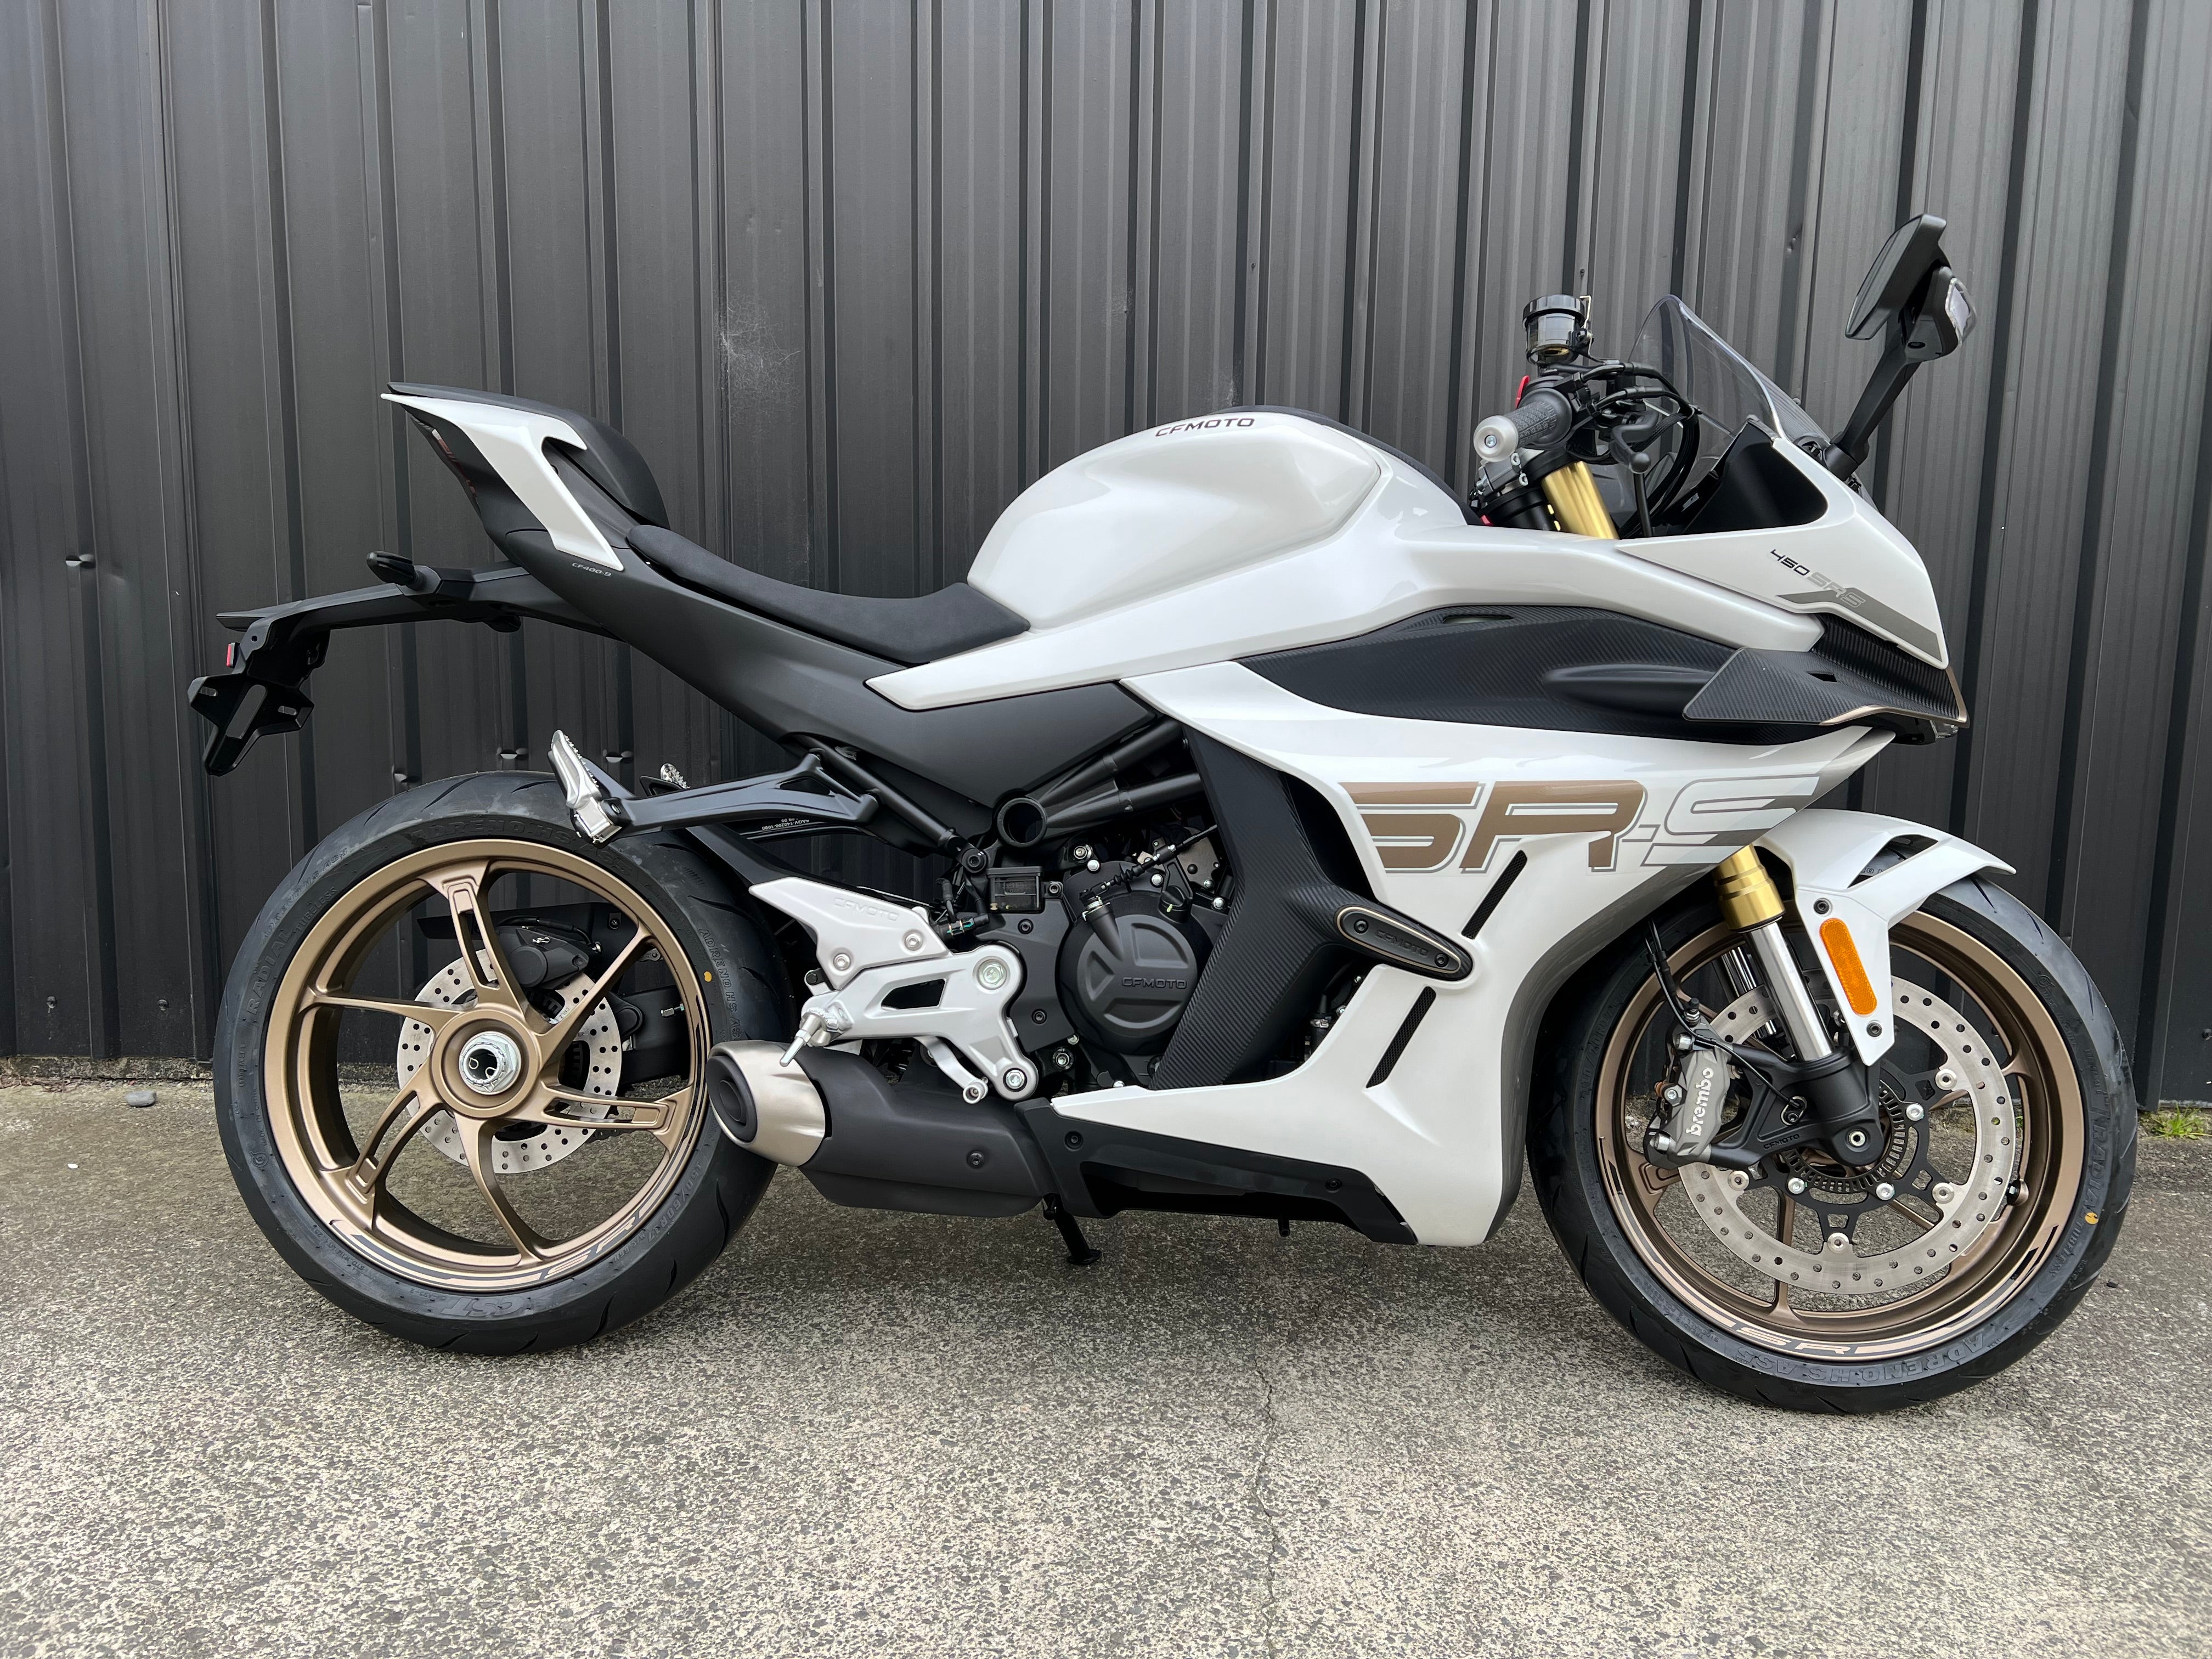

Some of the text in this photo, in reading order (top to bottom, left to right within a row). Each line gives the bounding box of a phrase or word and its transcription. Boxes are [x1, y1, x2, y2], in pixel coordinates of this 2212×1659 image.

[1155, 418, 1256, 437] CFMOTO
[572, 562, 612, 577] CF400-9
[1769, 549, 1810, 576] 450
[295, 886, 338, 932] TUBELESS
[834, 897, 899, 922] CFMOTO
[1374, 929, 1429, 958] CFMOTO
[698, 928, 732, 988] ADRENO
[246, 929, 294, 1015] RADIAL
[1121, 977, 1188, 990] CFMOTO
[725, 991, 738, 1013] HS
[730, 1017, 742, 1041] AS
[1685, 1066, 1714, 1137] brembo
[259, 1127, 268, 1147] MADE
[1763, 1133, 1800, 1149] CFMOTO
[648, 1162, 704, 1242] 150/60R17
[544, 1216, 635, 1279] SR
[440, 1296, 523, 1317] CST
[1736, 1326, 1851, 1355] SR
[1735, 1346, 1798, 1375] AS5
[1861, 1331, 1984, 1383] ADRENO
[1808, 1368, 1850, 1383] HS
